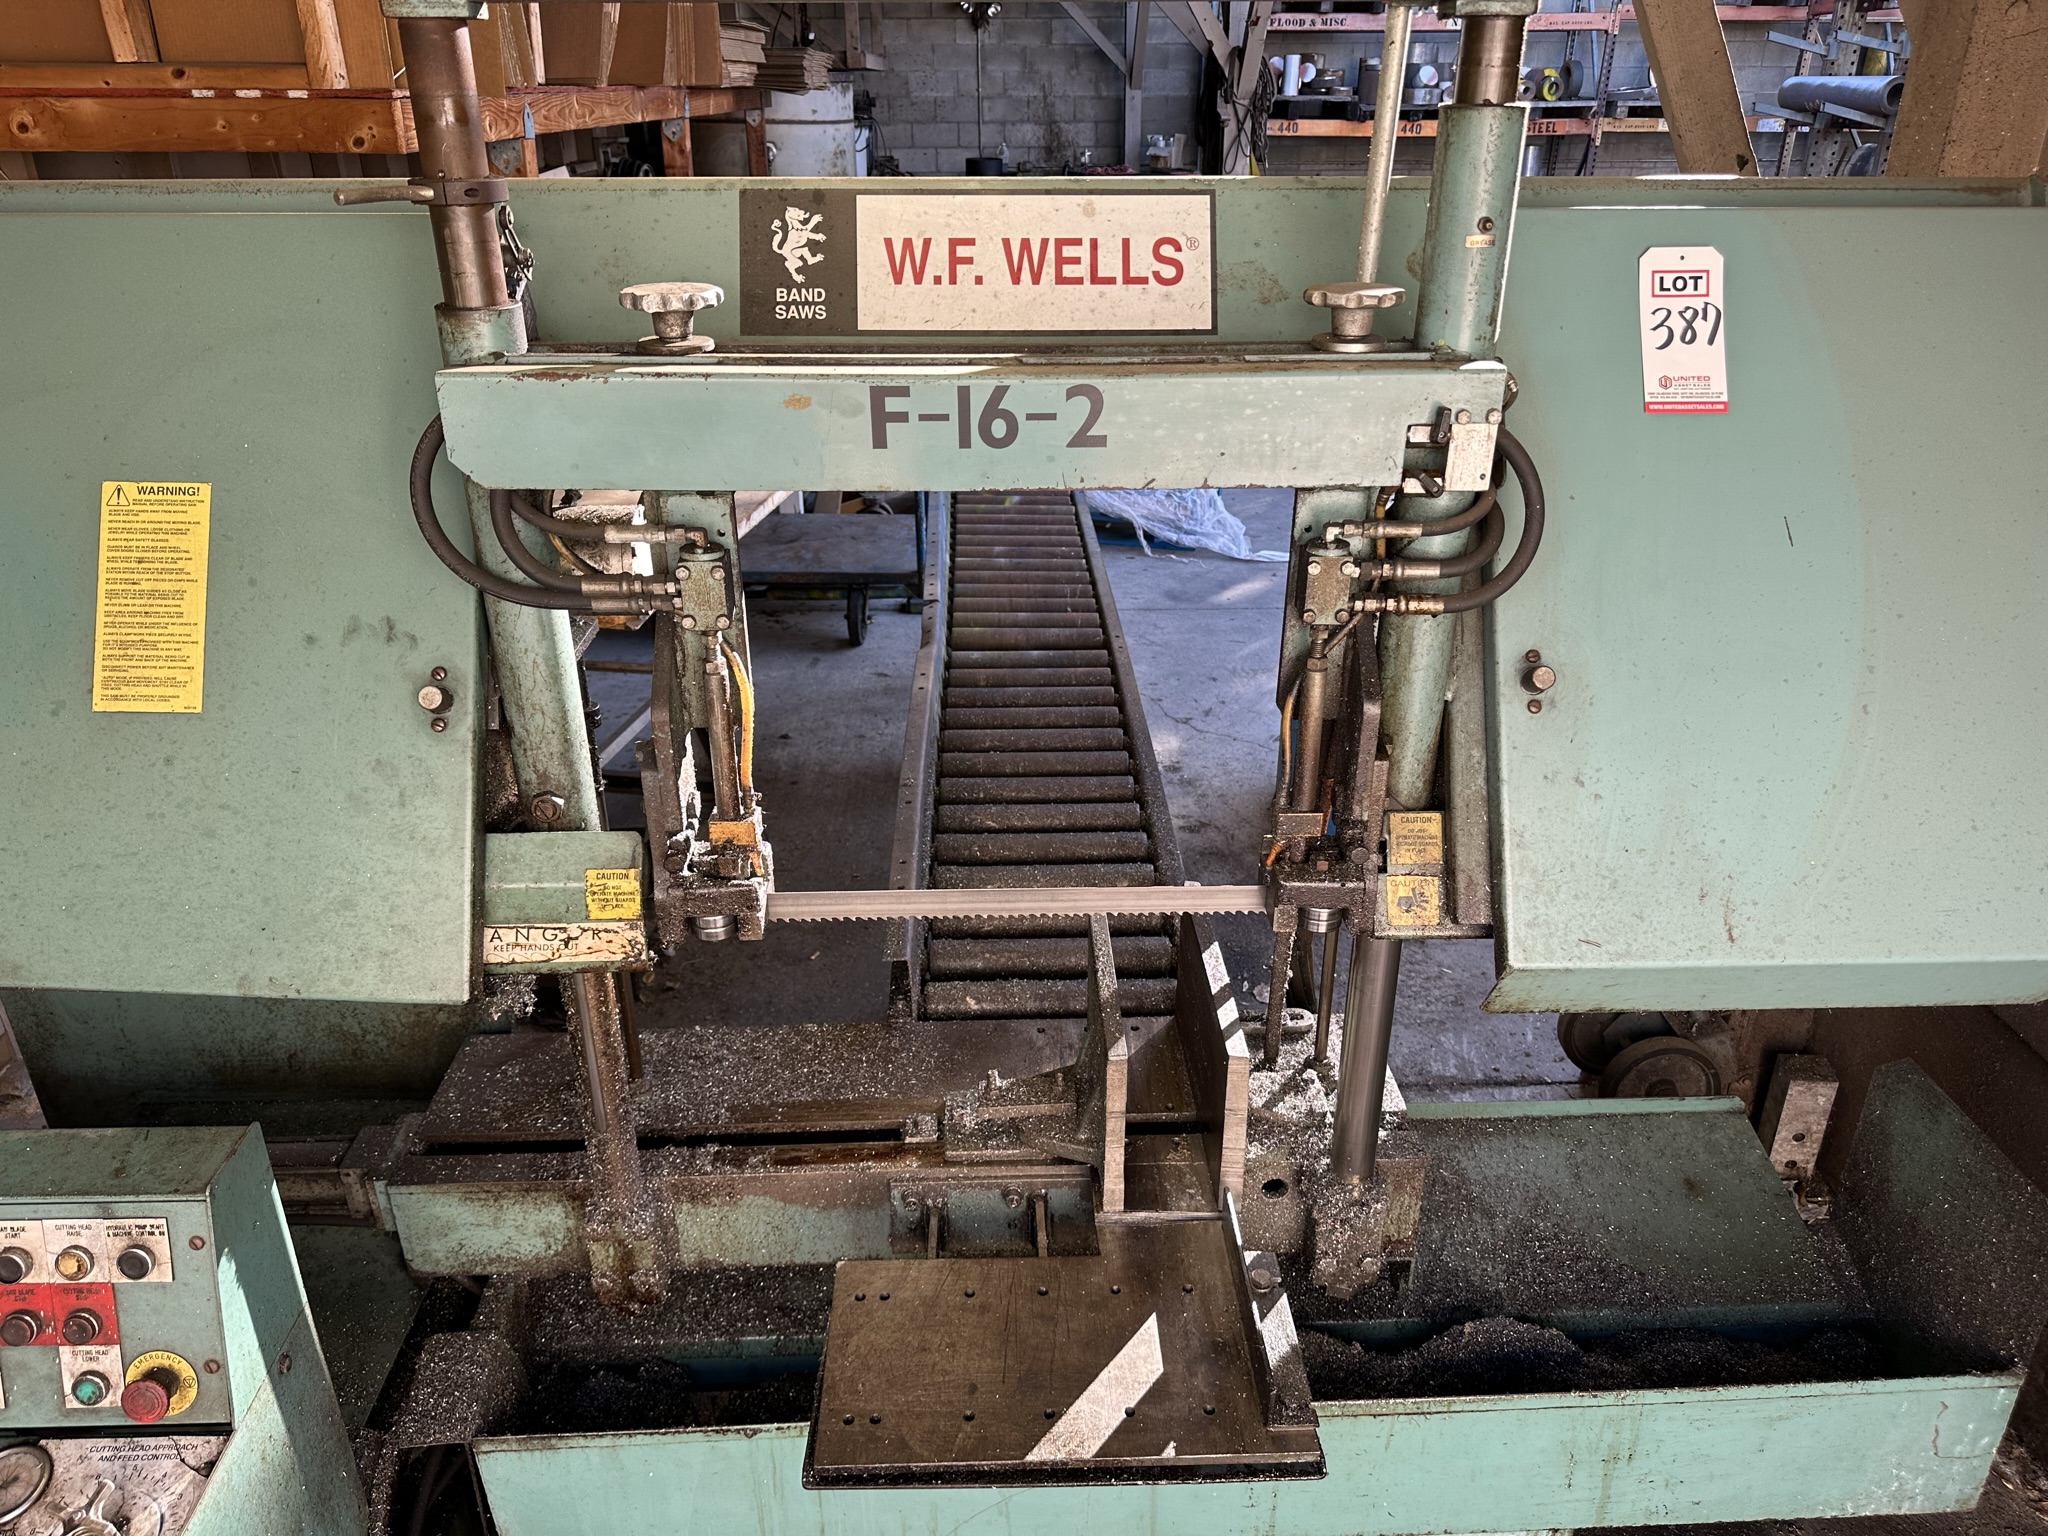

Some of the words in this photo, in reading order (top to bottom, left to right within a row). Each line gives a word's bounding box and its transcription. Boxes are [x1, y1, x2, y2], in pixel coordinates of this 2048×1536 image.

[1270, 18, 1306, 27] FLOOD
[1309, 18, 1316, 27] &
[1278, 122, 1298, 134] 440
[1401, 123, 1422, 135] 440
[884, 237, 983, 285] W.F.
[1659, 276, 1703, 292] LOT
[775, 288, 826, 302] BAND
[774, 305, 827, 320] SAWS
[1650, 301, 1721, 350] 387
[869, 384, 1108, 450] F-16-2
[137, 486, 200, 496] WARNING!
[134, 1353, 182, 1369] EMERGENCY
